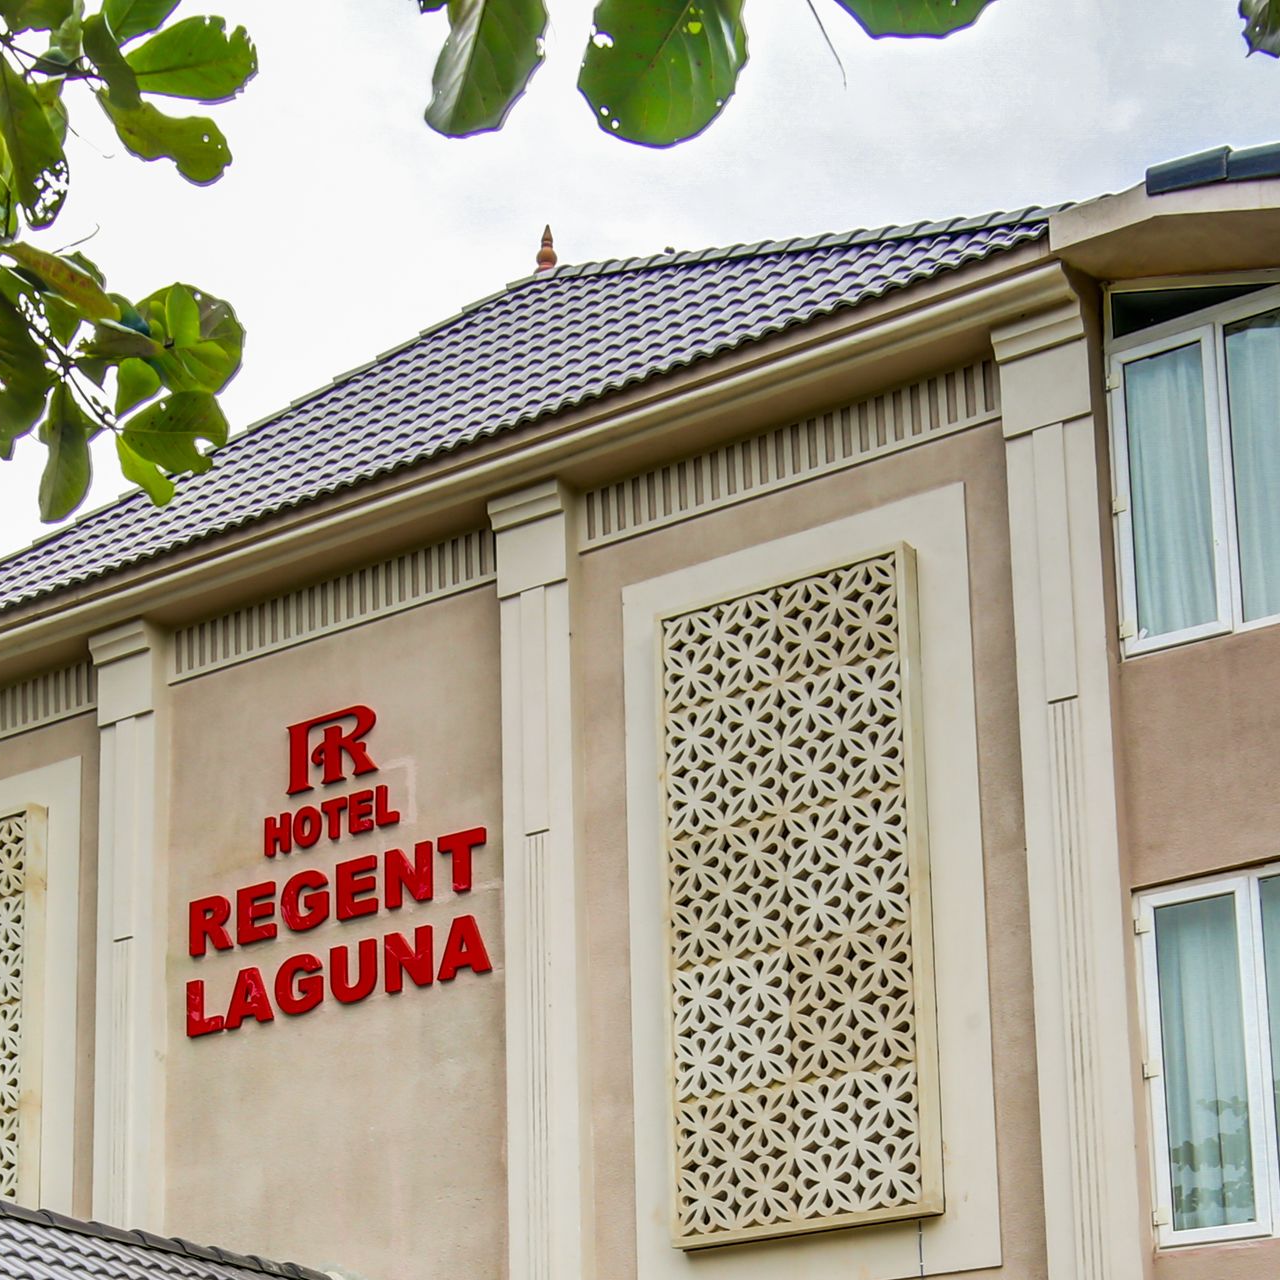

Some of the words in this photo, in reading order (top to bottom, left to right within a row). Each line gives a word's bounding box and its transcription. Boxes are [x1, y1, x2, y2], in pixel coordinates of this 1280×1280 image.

[263, 784, 401, 858] HOTEL
[188, 826, 487, 958] REGENT
[186, 914, 493, 1038] LAGUNA
